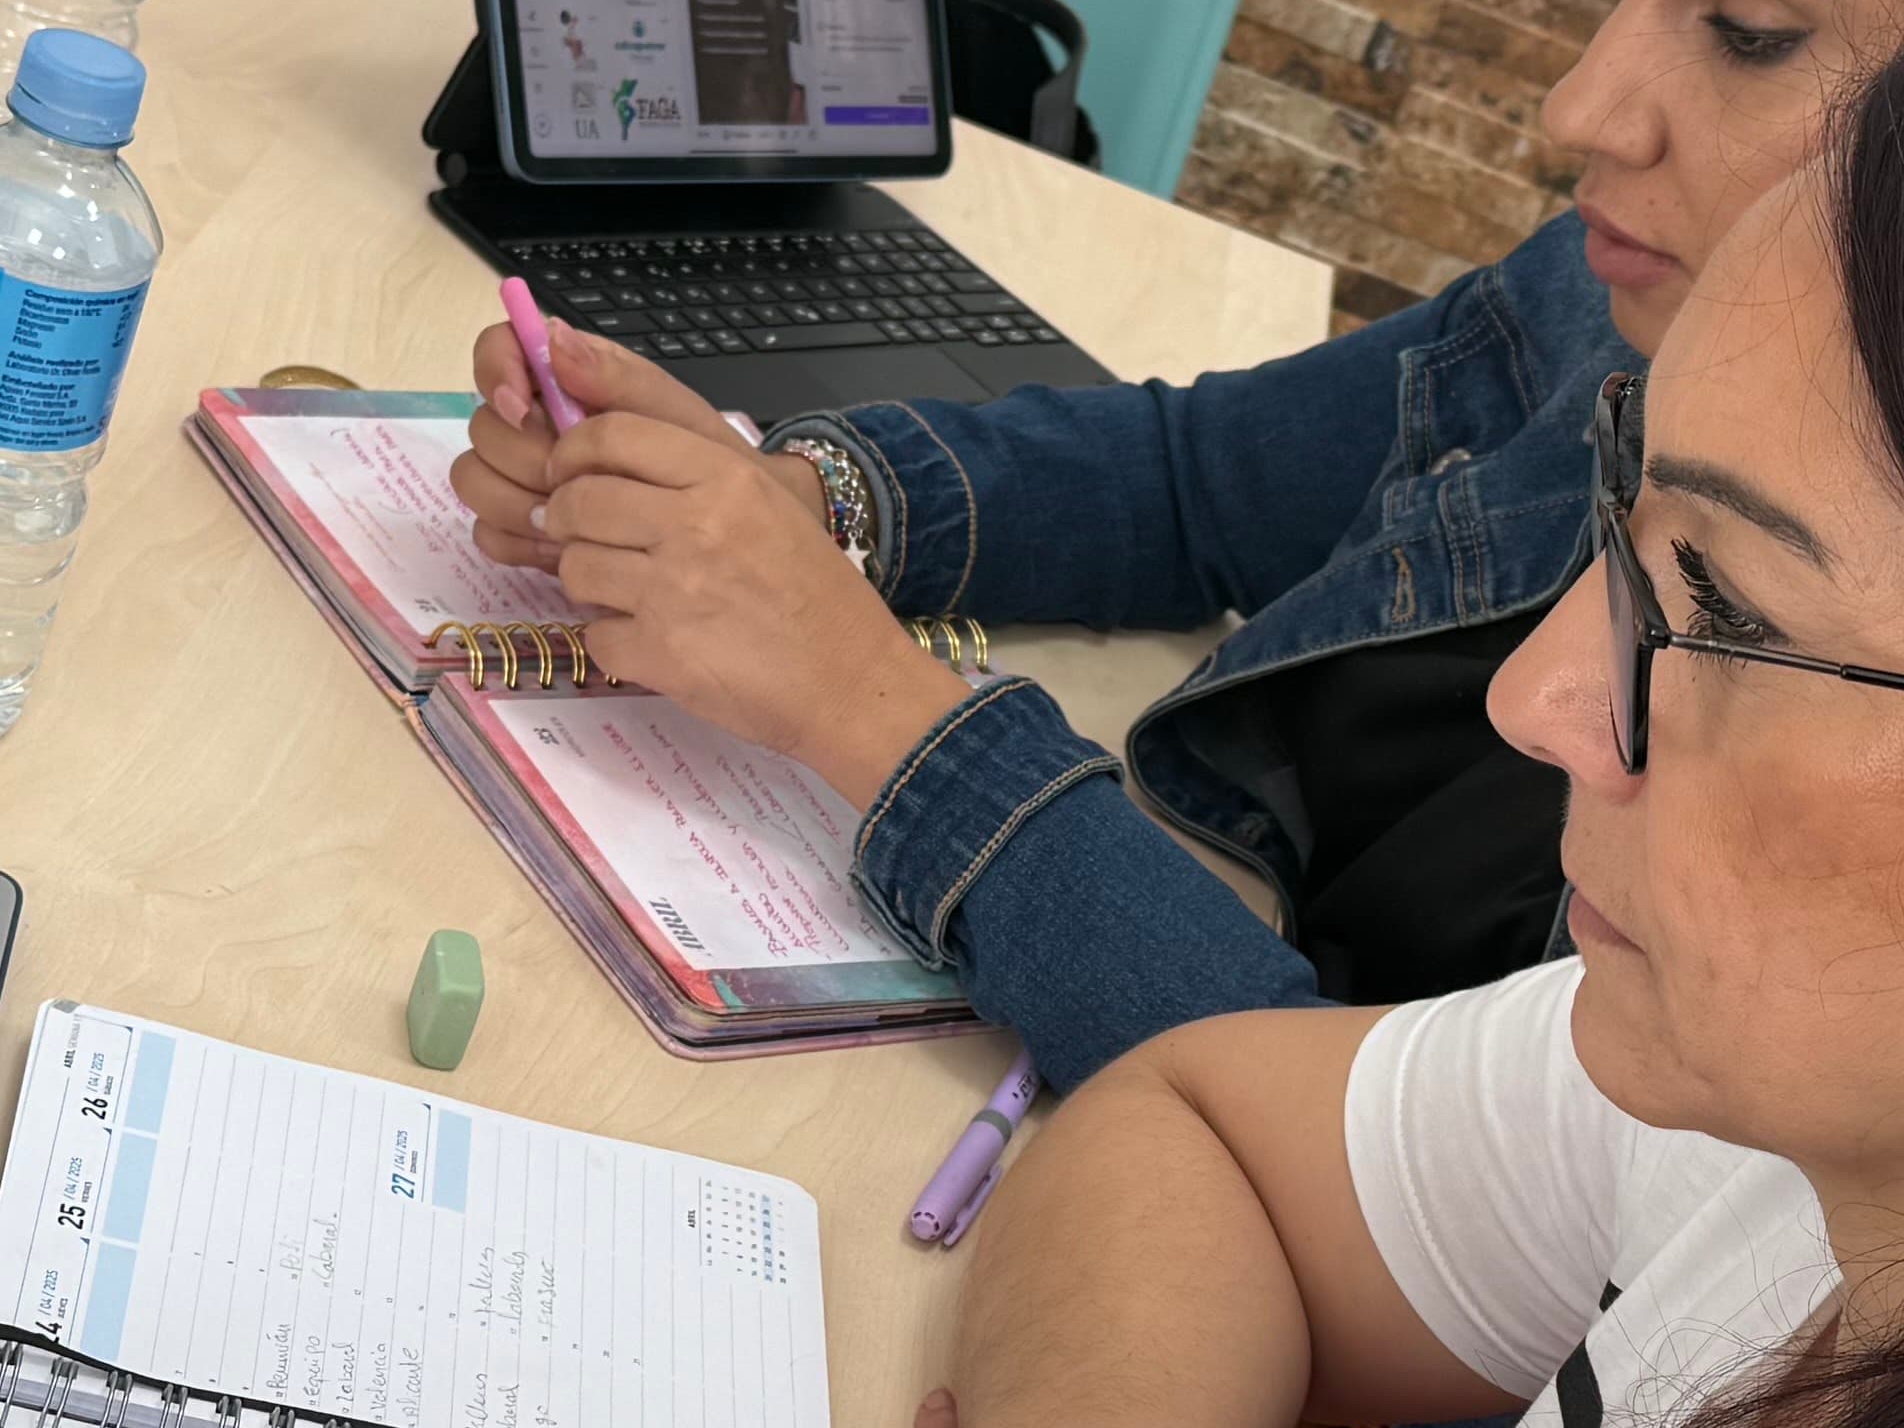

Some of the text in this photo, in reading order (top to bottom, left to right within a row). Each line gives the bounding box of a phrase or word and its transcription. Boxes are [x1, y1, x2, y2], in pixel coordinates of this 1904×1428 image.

[636, 97, 682, 121] FAGA
[82, 1098, 108, 1120] 26
[391, 1173, 415, 1198] 27
[58, 1204, 85, 1229] 25
